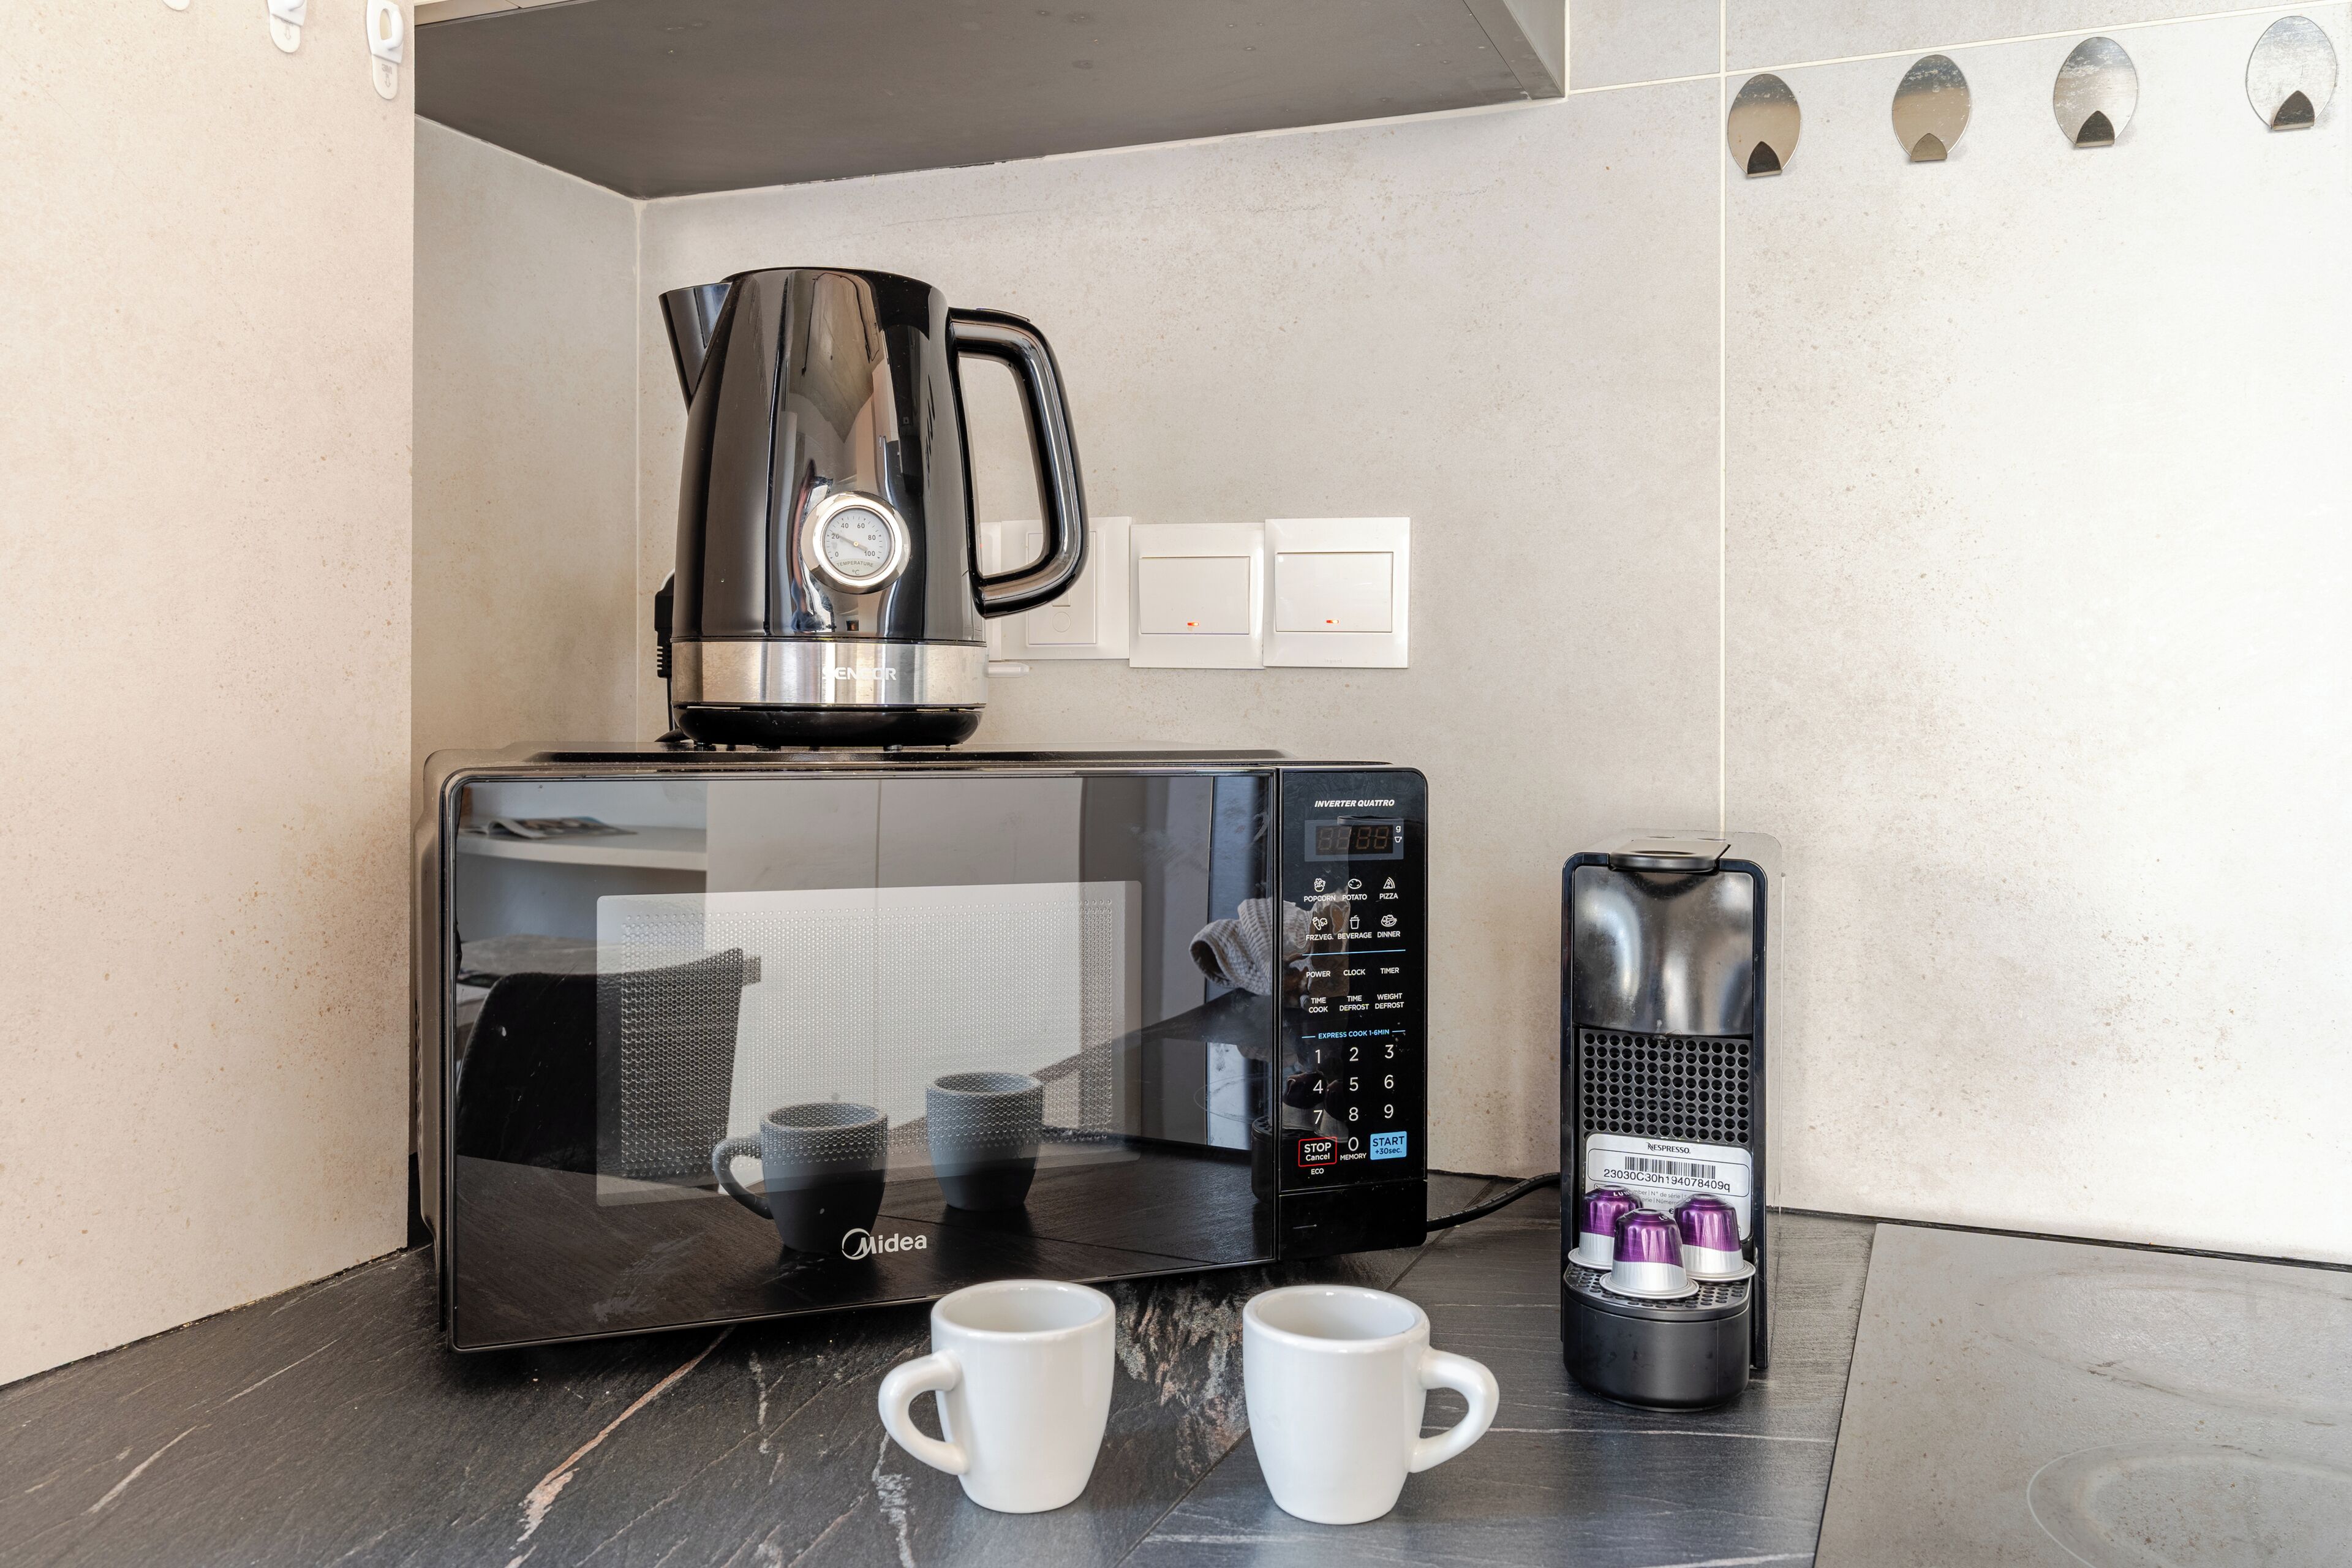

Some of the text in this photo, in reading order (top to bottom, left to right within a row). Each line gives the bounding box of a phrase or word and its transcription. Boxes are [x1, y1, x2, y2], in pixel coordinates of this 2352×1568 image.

[1315, 1049, 1321, 1063] 1
[1349, 1047, 1359, 1061] 2
[1384, 1044, 1394, 1058] 3
[1313, 1080, 1323, 1094] 4
[1349, 1077, 1359, 1091] 5
[1384, 1074, 1394, 1089] 6
[1313, 1110, 1322, 1124] 7
[1349, 1107, 1359, 1121] 8
[1384, 1104, 1393, 1118] 9
[1304, 1142, 1332, 1153] STOP
[1373, 1136, 1404, 1147] START
[1306, 1153, 1330, 1161] Cancel
[842, 1228, 927, 1260] Midea
